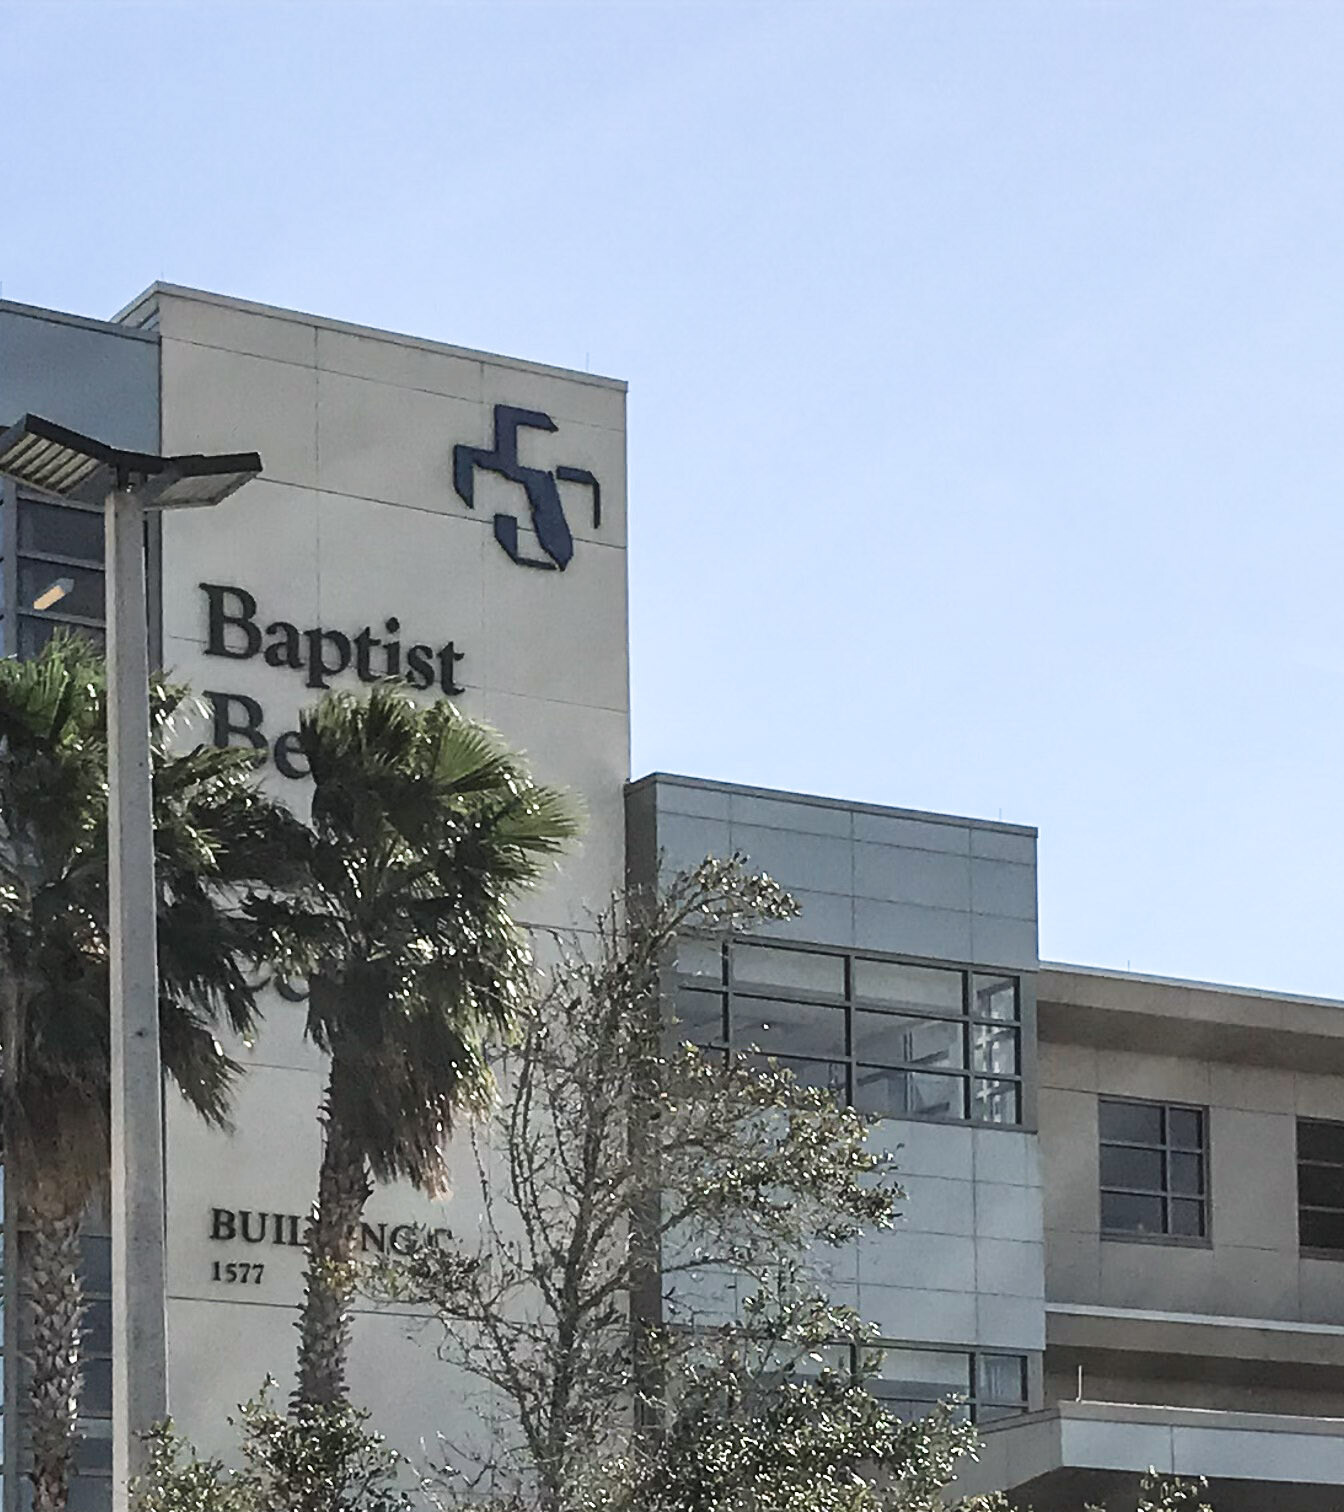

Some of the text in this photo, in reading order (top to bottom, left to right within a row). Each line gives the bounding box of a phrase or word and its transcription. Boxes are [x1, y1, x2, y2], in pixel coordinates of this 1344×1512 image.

[198, 582, 465, 696] Baptist
[209, 1207, 418, 1256] BUILNG
[212, 1260, 265, 1285] 1577
